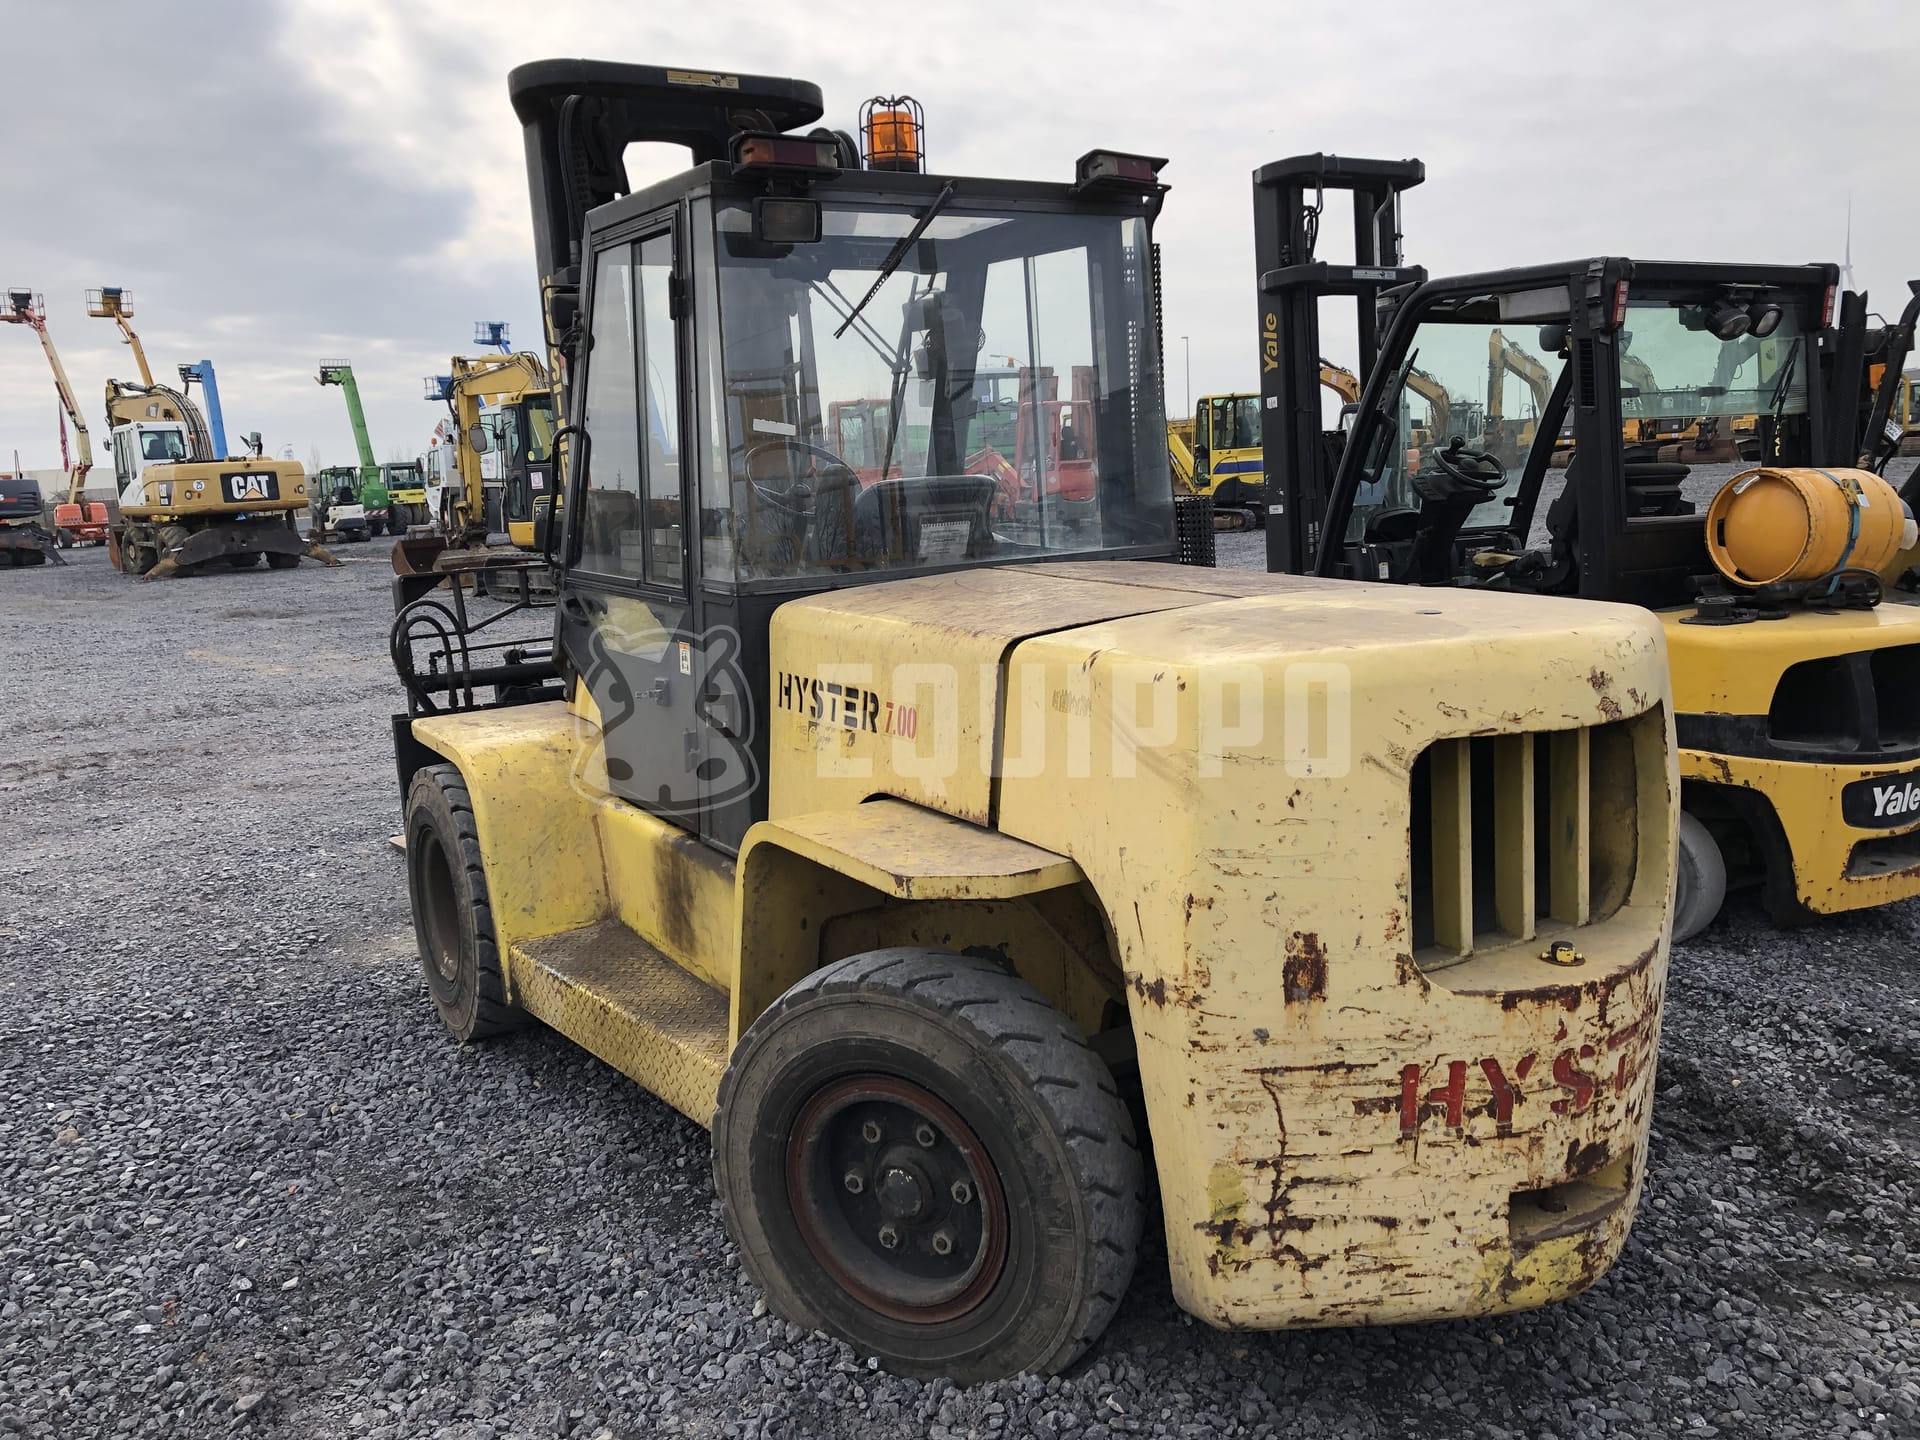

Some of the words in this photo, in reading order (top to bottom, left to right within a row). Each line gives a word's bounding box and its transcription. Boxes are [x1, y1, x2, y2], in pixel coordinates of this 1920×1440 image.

[1263, 313, 1279, 373] Yale
[231, 475, 270, 499] CAT
[779, 672, 879, 733] HYSTER
[884, 701, 917, 739] 7.00
[1872, 782, 1920, 817] Yale
